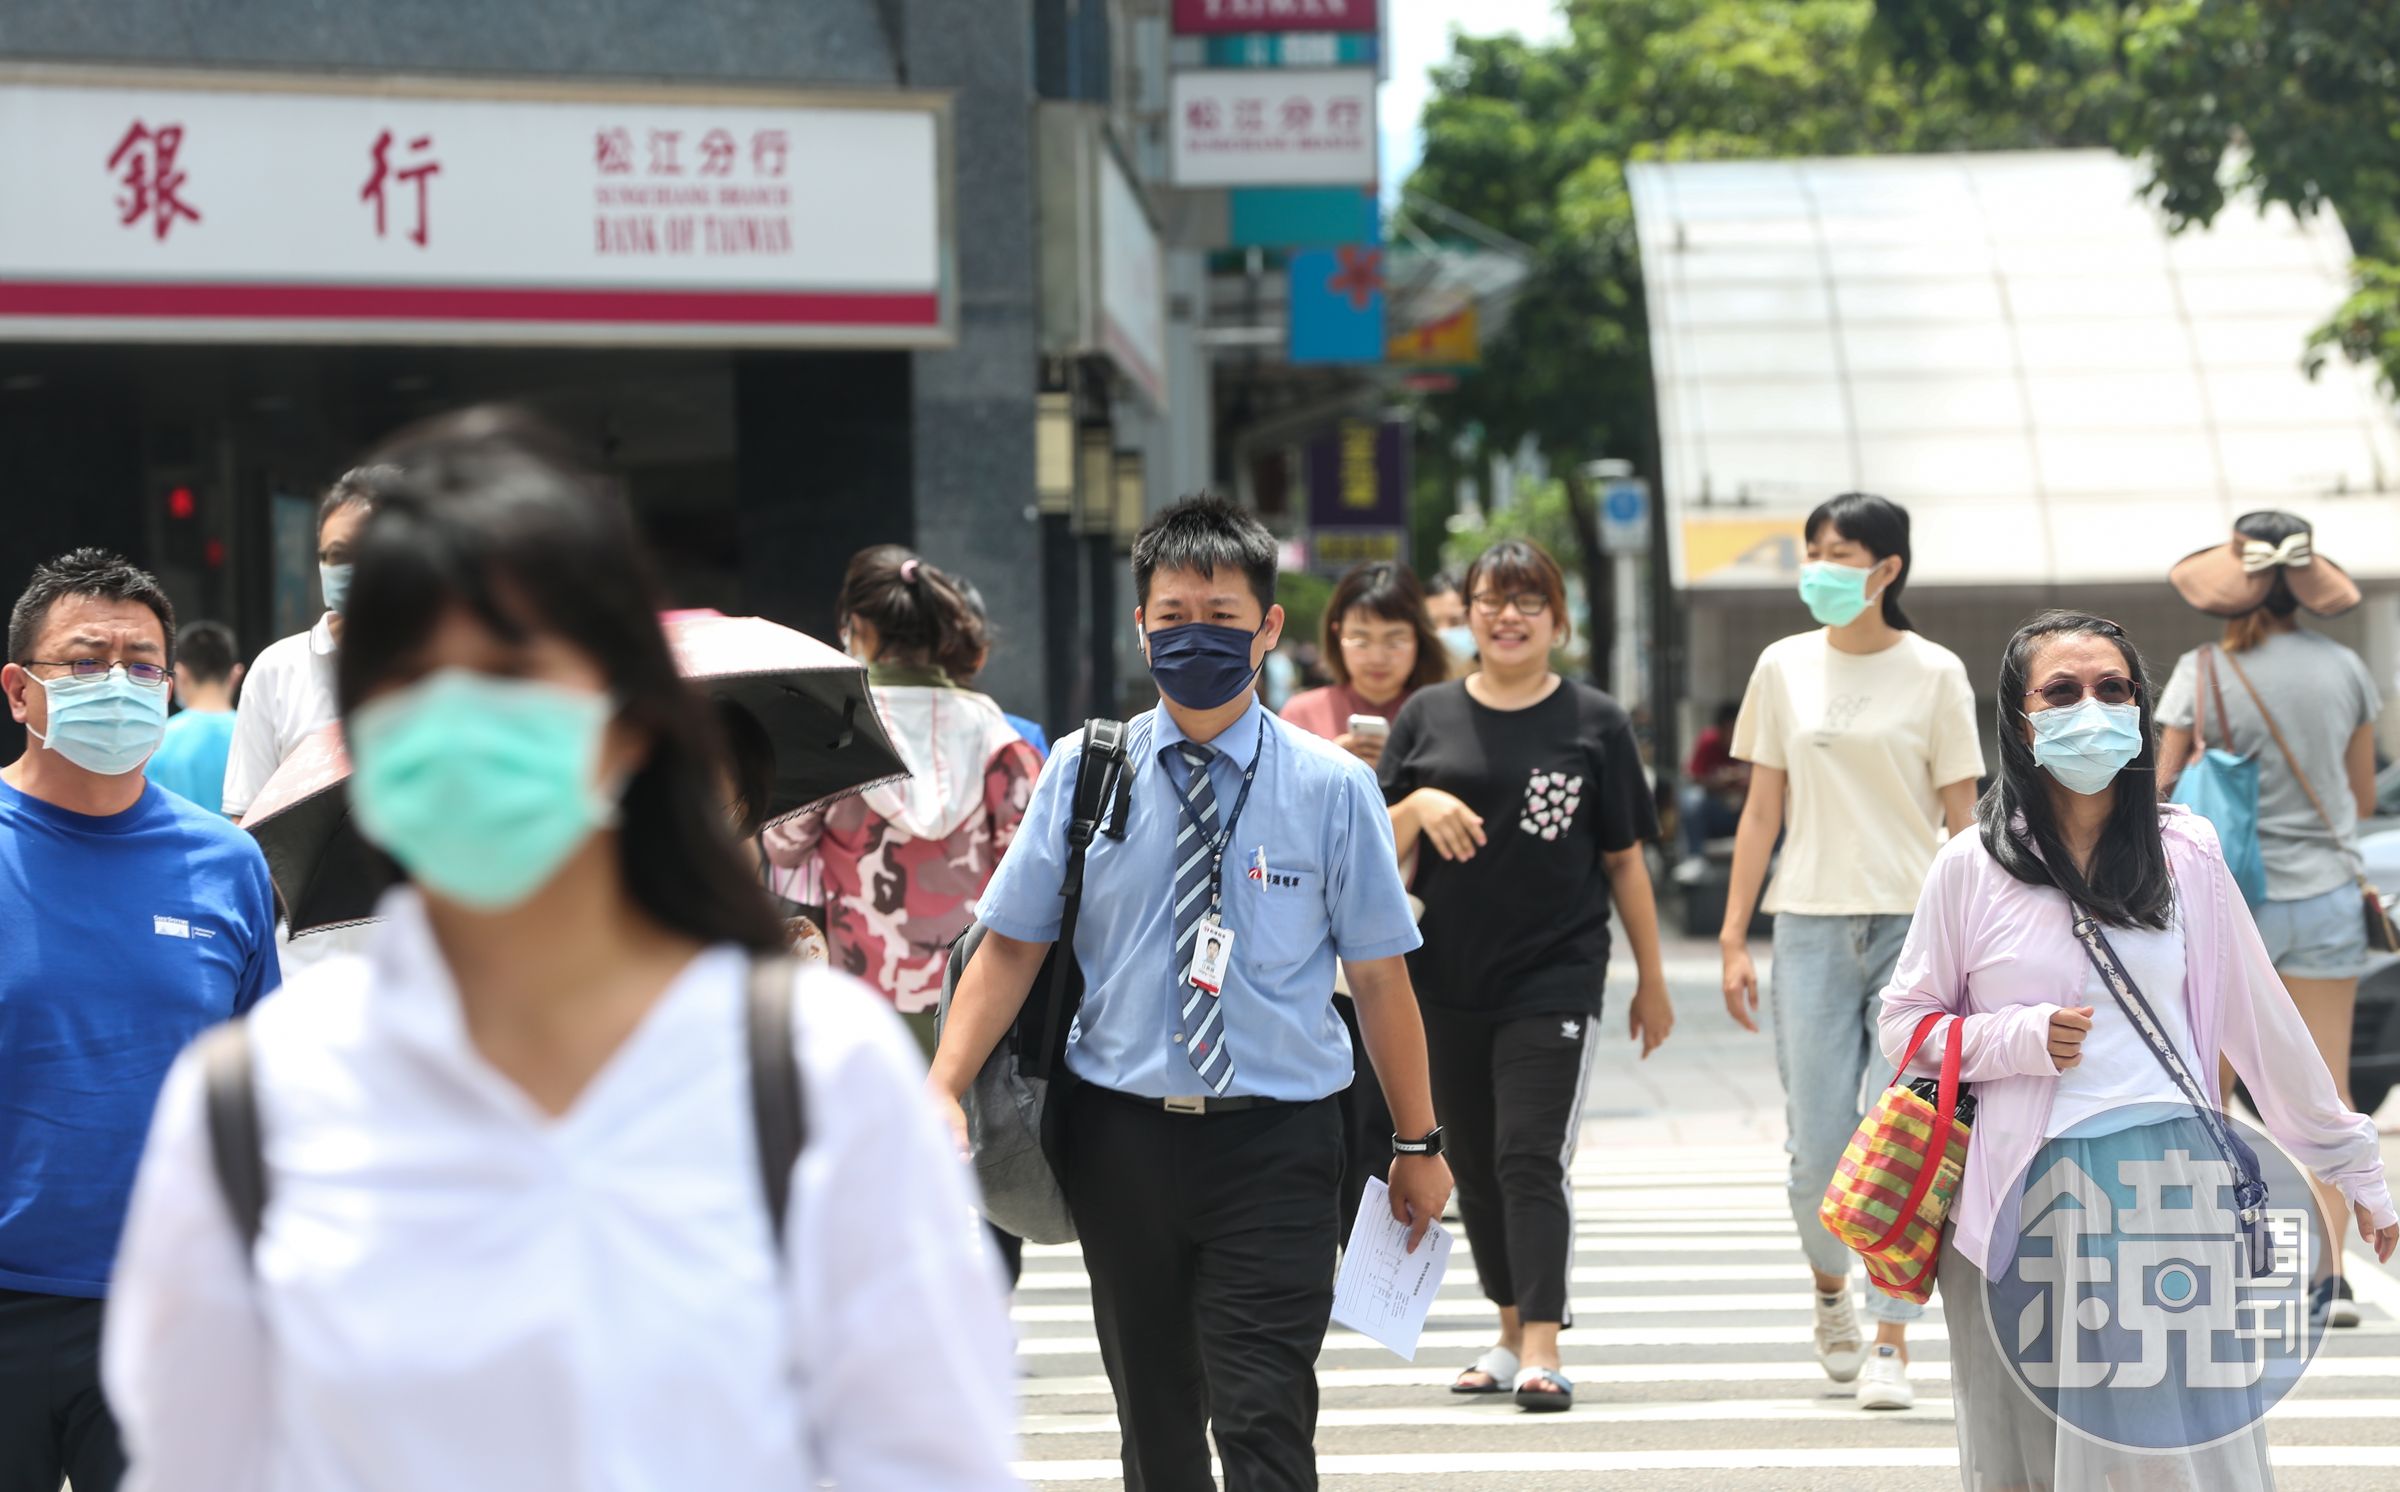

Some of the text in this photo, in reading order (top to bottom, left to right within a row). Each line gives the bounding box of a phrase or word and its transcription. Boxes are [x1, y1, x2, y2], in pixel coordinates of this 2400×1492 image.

[595, 126, 791, 177] 松江分行
[106, 117, 442, 248] 銀行
[596, 215, 794, 255] BANK OF TAIWAN
